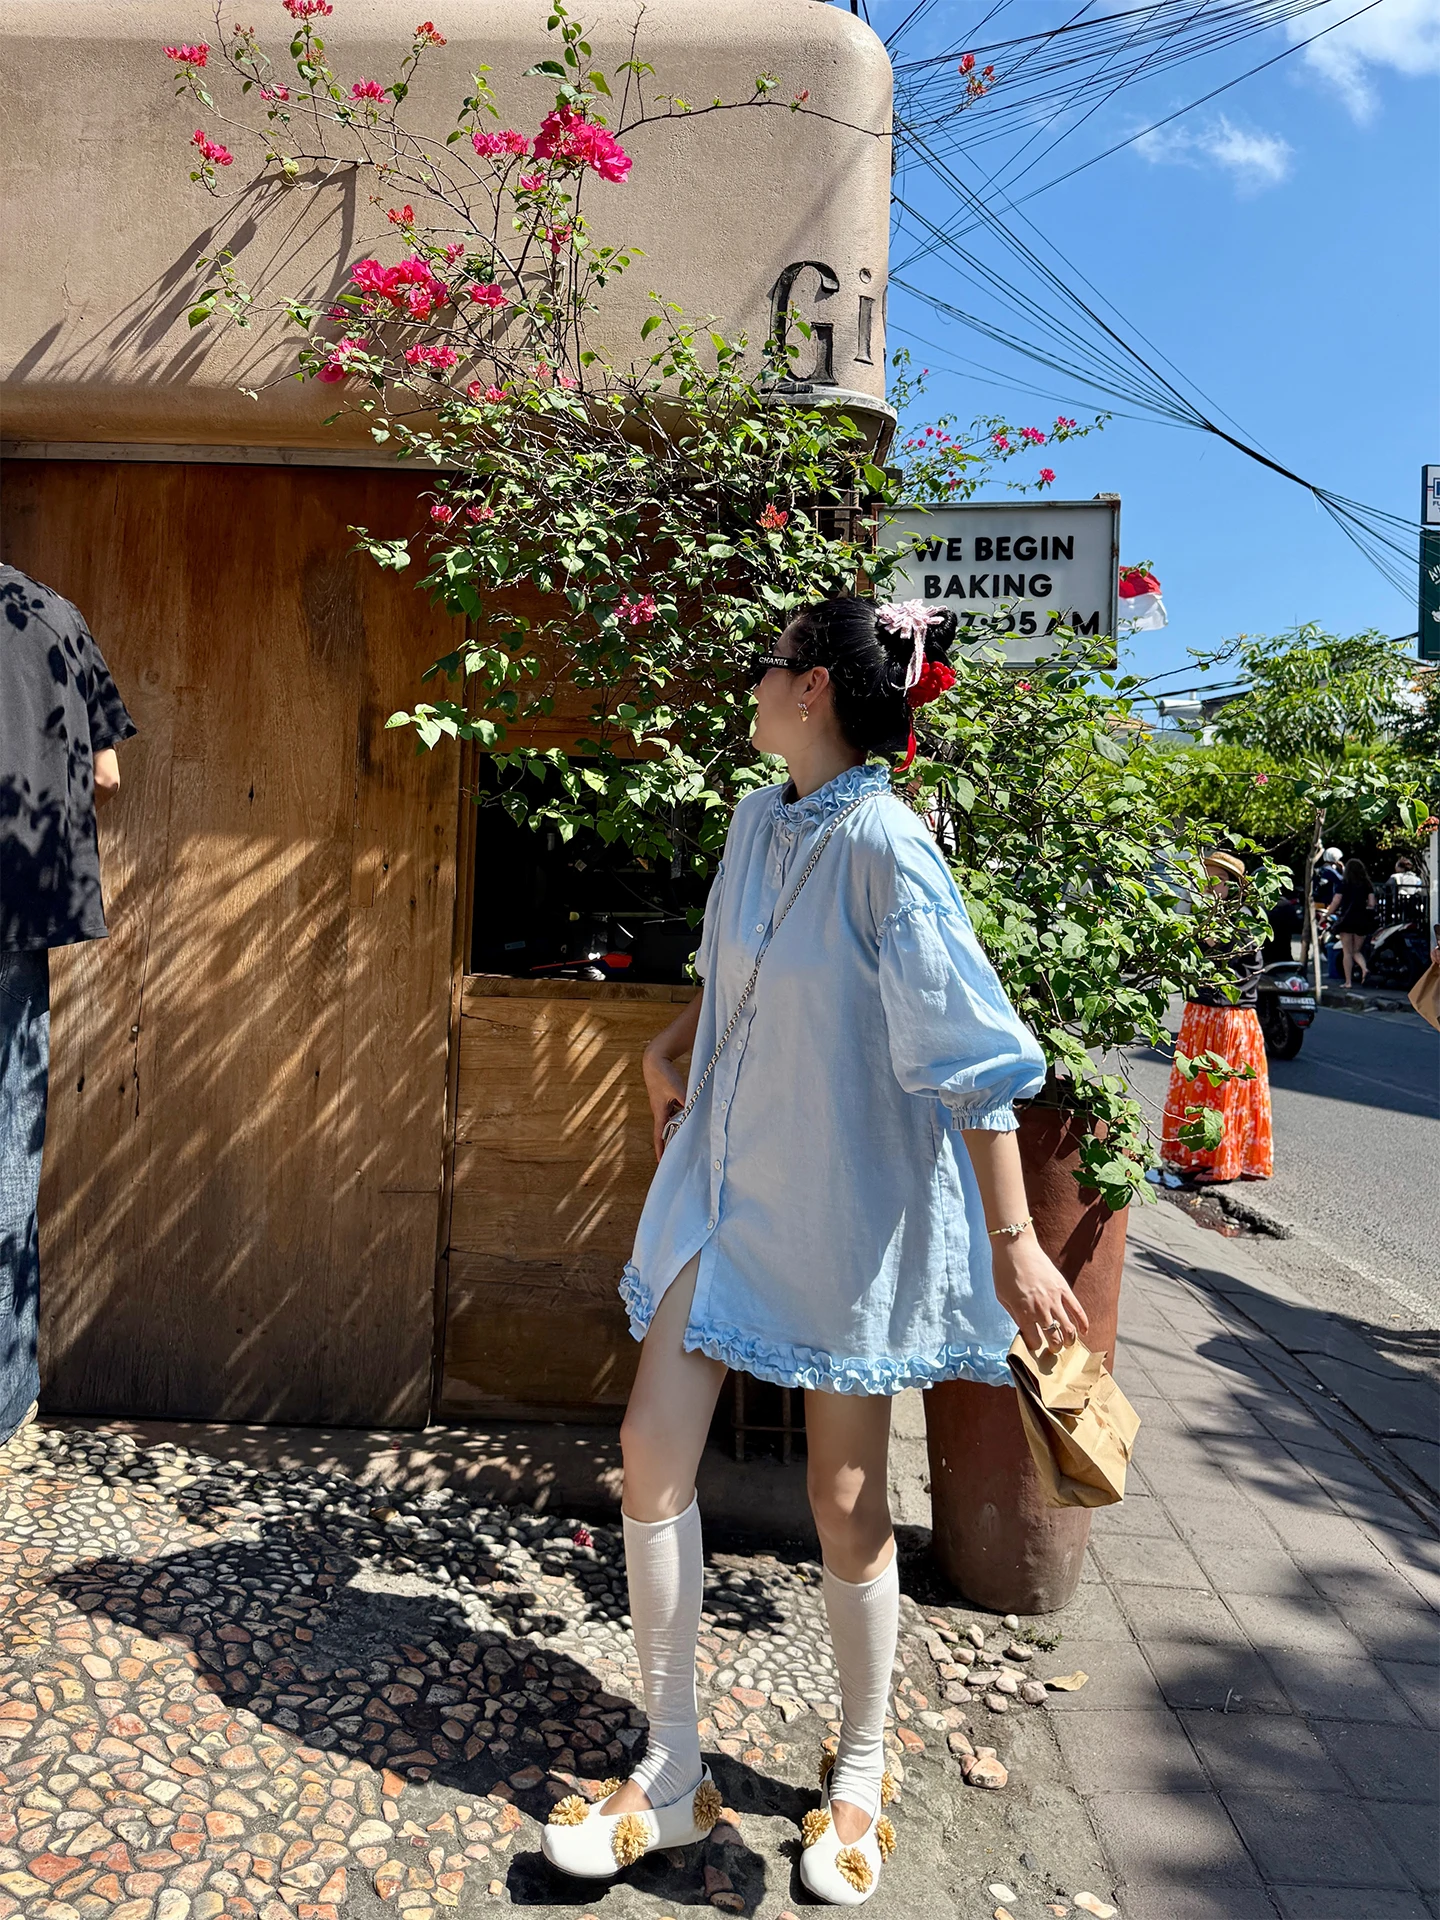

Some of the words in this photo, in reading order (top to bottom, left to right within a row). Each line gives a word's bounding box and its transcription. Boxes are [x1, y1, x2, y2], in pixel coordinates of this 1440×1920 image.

[768, 260, 887, 387] Gi
[912, 537, 962, 562] WE
[974, 535, 1074, 562] BEGIN
[924, 573, 1053, 599] BAKING
[1045, 609, 1100, 636] AM
[758, 656, 789, 667] CHANEL
